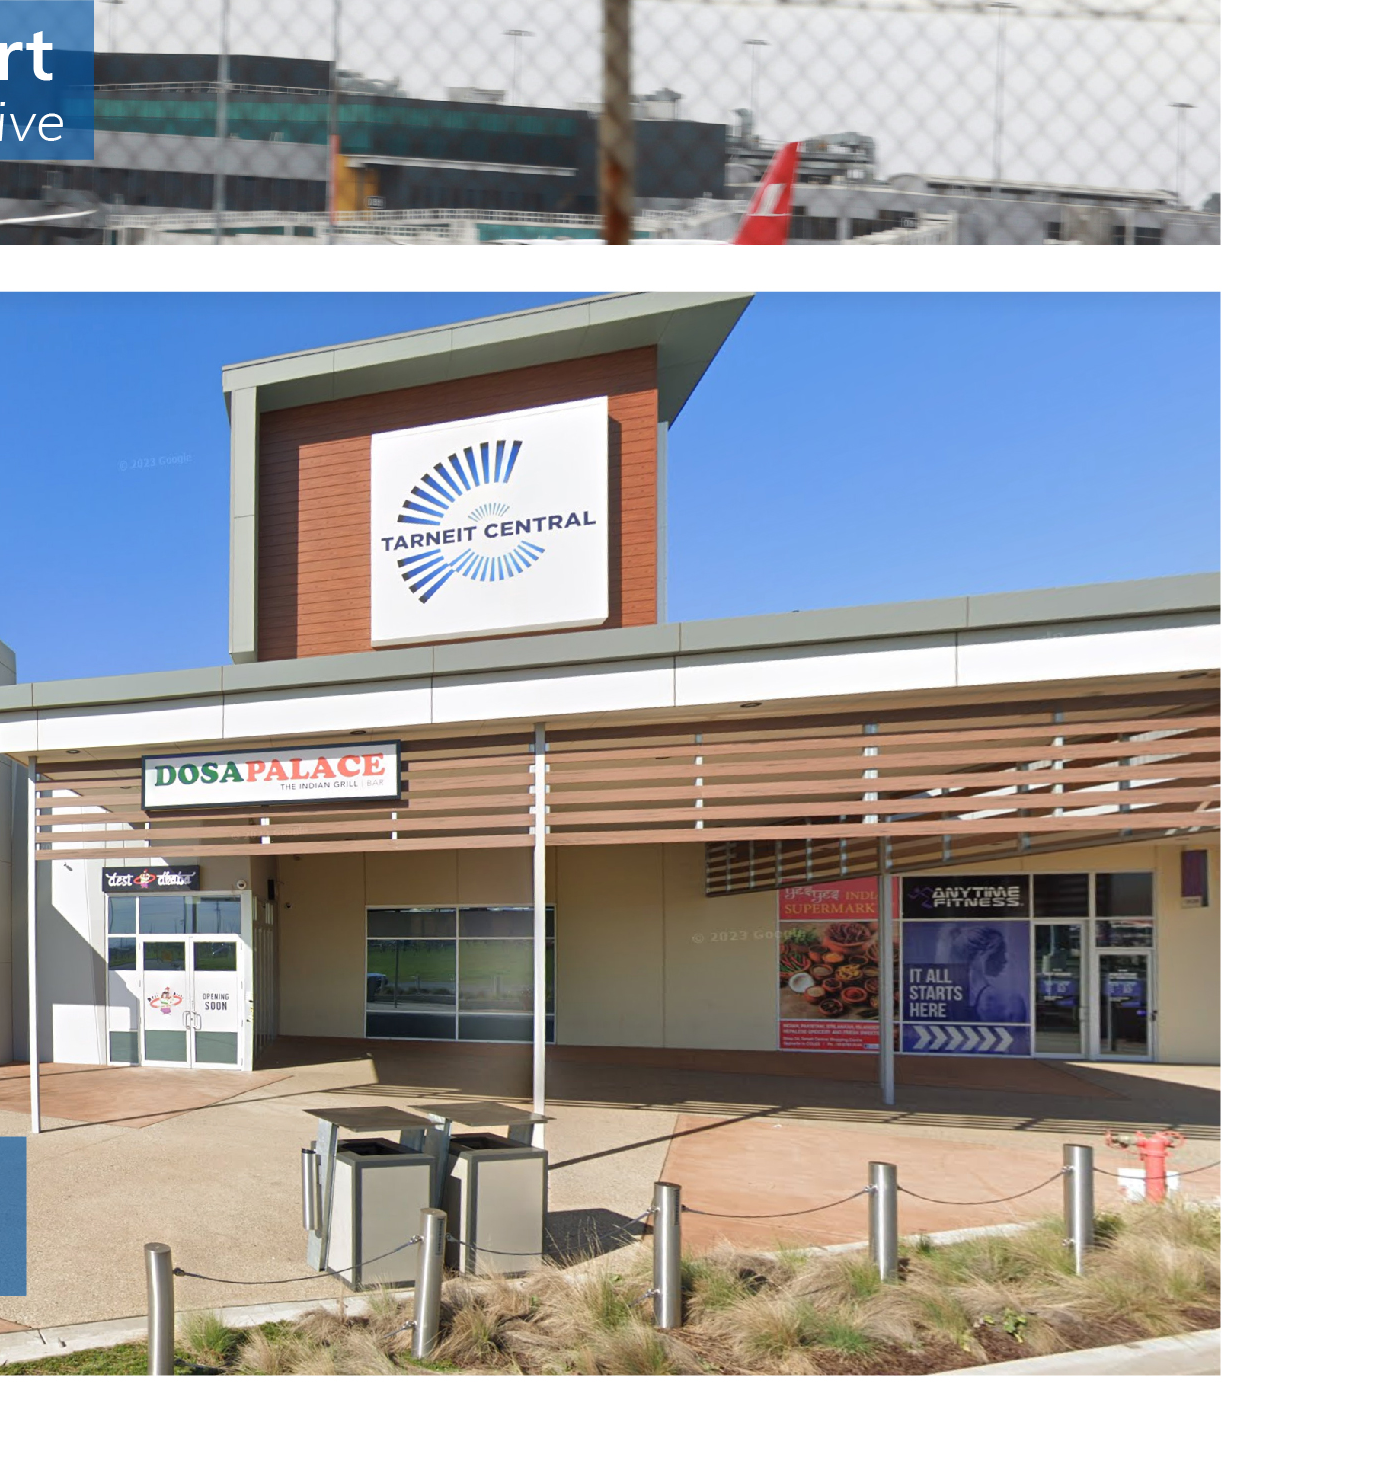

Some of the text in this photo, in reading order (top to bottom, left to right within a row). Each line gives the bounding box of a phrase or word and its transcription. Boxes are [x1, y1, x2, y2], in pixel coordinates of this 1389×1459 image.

[381, 511, 596, 551] TARNEIT CENTRAL
[280, 779, 384, 791] THE INDIAN GRILL BAR
[931, 886, 1020, 898] ANYTIME
[933, 897, 1021, 908] FITNESS
[784, 903, 875, 915] SUPERMARK
[909, 968, 952, 983] IT ALL
[202, 993, 230, 1001] OPENING
[909, 985, 963, 1001] STARTS
[205, 1001, 228, 1011] SOON
[909, 1003, 947, 1018] HERE
